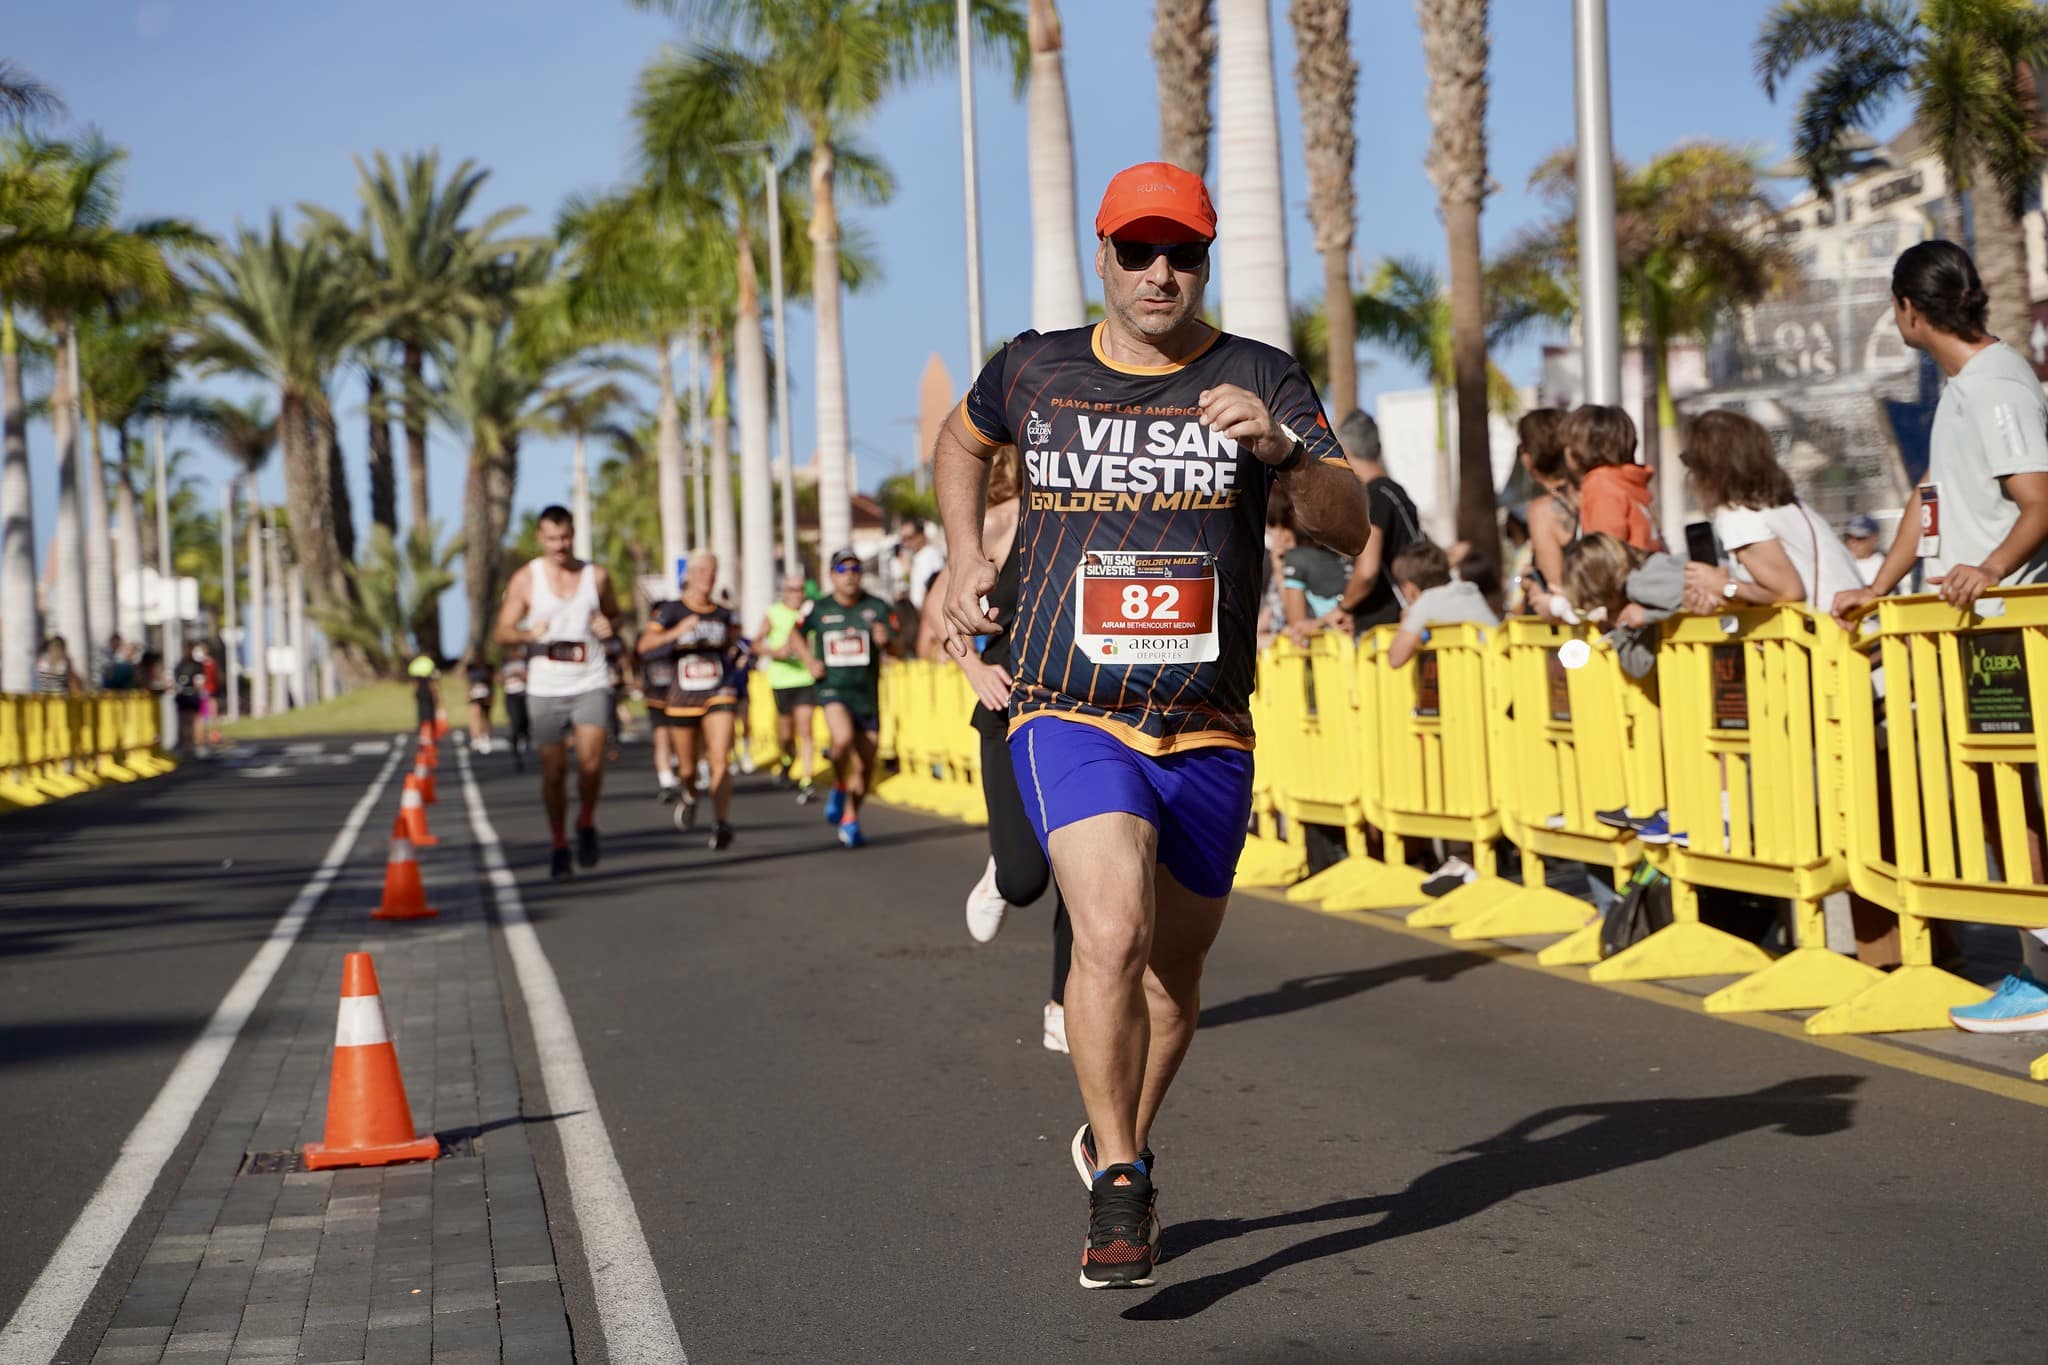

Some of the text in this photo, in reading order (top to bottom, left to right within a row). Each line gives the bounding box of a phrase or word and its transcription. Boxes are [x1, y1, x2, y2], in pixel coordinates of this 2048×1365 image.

[1051, 398, 1203, 417] PLAYA DE LAS AMÉRICA
[1077, 415, 1239, 459] VII SAN
[1025, 450, 1237, 496] SILVESTRE
[1031, 488, 1242, 512] GOLDEN MILLE
[1101, 555, 1136, 566] VII SAN
[1136, 557, 1198, 566] GOLDEN MILLE
[1087, 566, 1136, 576] SILVESTRE
[1121, 584, 1180, 620] 82
[1102, 621, 1126, 629] AIRAM
[1127, 621, 1172, 629] BETHENCOURT
[1136, 651, 1182, 660] DEPORTES
